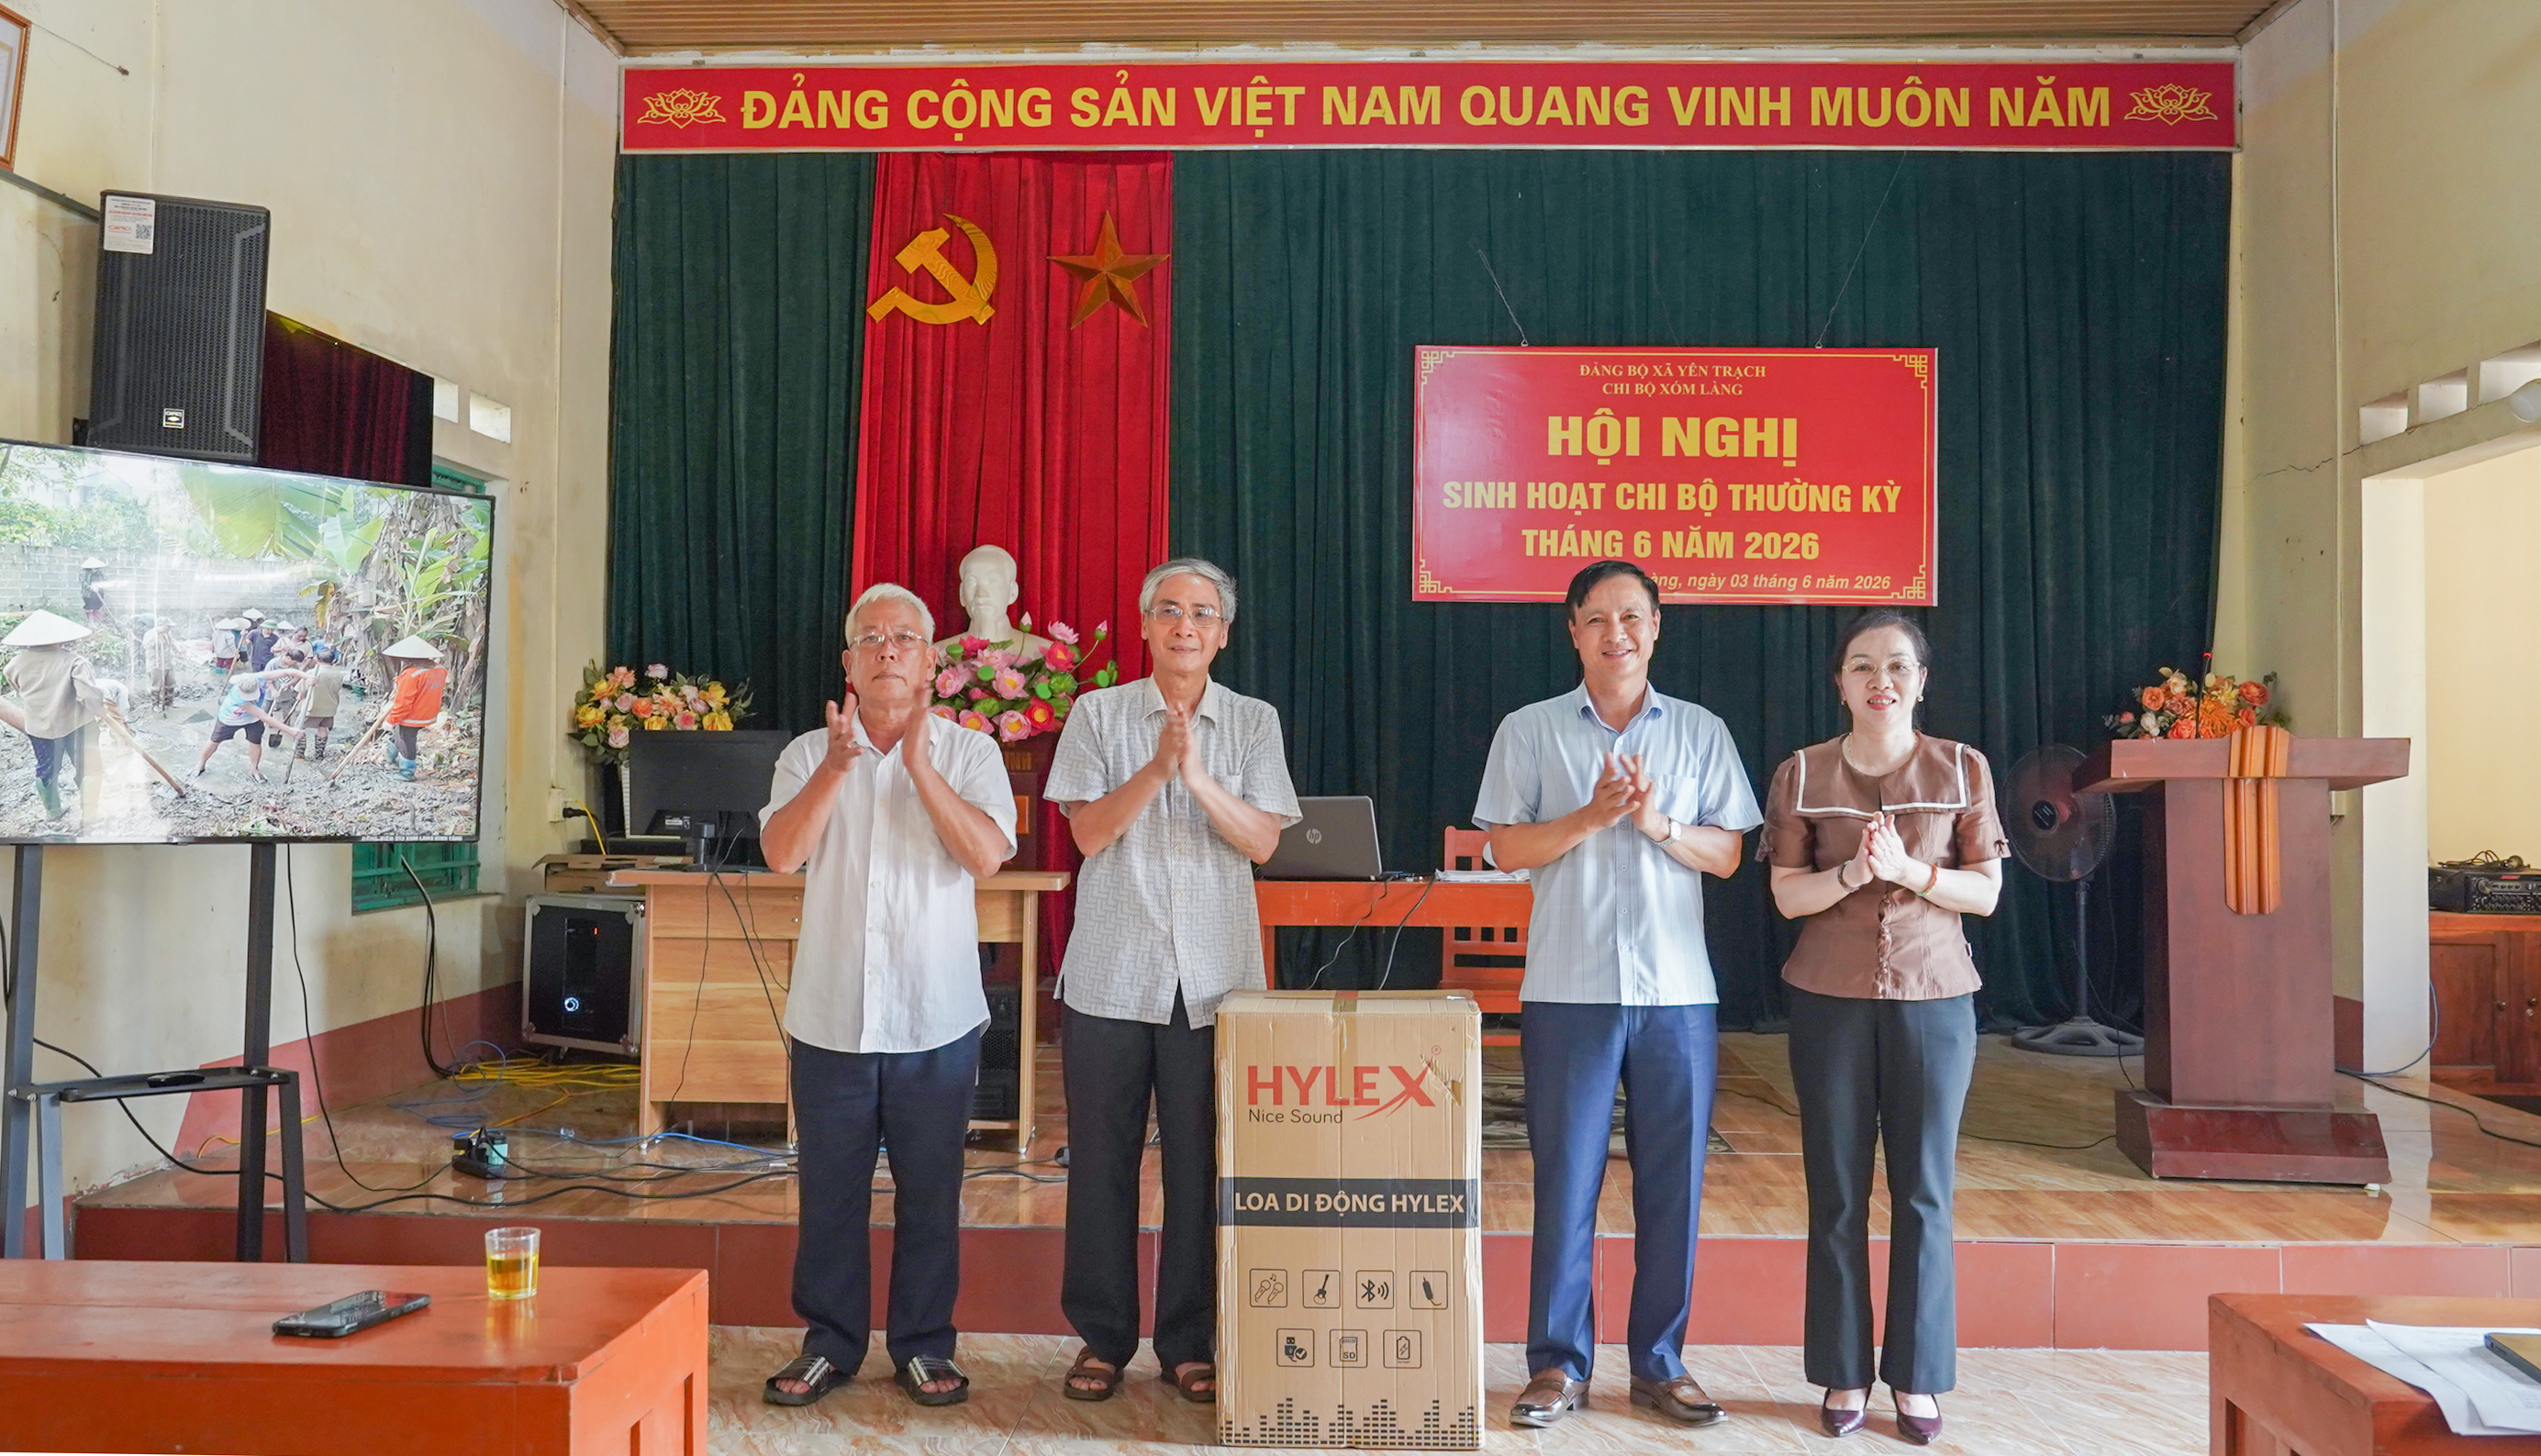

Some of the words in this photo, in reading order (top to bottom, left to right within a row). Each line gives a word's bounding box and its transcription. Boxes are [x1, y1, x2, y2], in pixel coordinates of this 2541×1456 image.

[741, 73, 889, 130] ĐẢNG
[907, 79, 1053, 142] CỘNG
[1070, 70, 1177, 128] SẢN
[1194, 75, 1307, 139] VIỆT
[1322, 85, 1442, 127] NAM
[1460, 85, 1650, 128] QUANG
[1667, 86, 1792, 127] VINH
[1811, 76, 1971, 128] MUÔN
[1989, 76, 2111, 128] NĂM
[1579, 361, 1623, 377] ĐẢNG
[1628, 363, 1649, 380] BỘ
[1653, 363, 1674, 377] XÃ
[1677, 362, 1709, 377] YÊN
[1712, 365, 1766, 380] TRẠCH
[1602, 383, 1630, 395] CHI
[1635, 381, 1656, 398] BỘ
[1659, 381, 1696, 395] XÓM
[1700, 381, 1744, 396] LÀNG
[1548, 407, 1641, 466] HỘI
[1663, 417, 1798, 468] NGHỊ
[1443, 481, 1517, 510] SINH
[1527, 483, 1607, 517] HOẠT
[1616, 483, 1667, 511] CHI
[1677, 478, 1719, 517] BỘ
[1728, 478, 1852, 514] THƯỜNG
[1862, 479, 1902, 514] KỲ
[1522, 524, 1624, 558] THÁNG
[1634, 531, 1653, 559] 6
[1663, 525, 1734, 560] NĂM
[1744, 532, 1821, 561] 2026
[1651, 572, 1683, 590] àng,
[1687, 573, 1727, 592] ngày
[1730, 574, 1749, 588] 03
[1753, 574, 1798, 592] tháng
[1801, 575, 1812, 589] 6
[1816, 574, 1850, 589] năm
[1853, 576, 1892, 590] 2026
[1247, 1063, 1436, 1109] HYLEX
[1249, 1109, 1284, 1124] Nice
[1290, 1108, 1343, 1125] Sound
[1235, 1192, 1280, 1212] LOA
[1286, 1193, 1310, 1212] DI
[1315, 1190, 1386, 1217] ĐỘNG
[1391, 1194, 1465, 1214] HYLEX
[1343, 1351, 1356, 1360] SD
